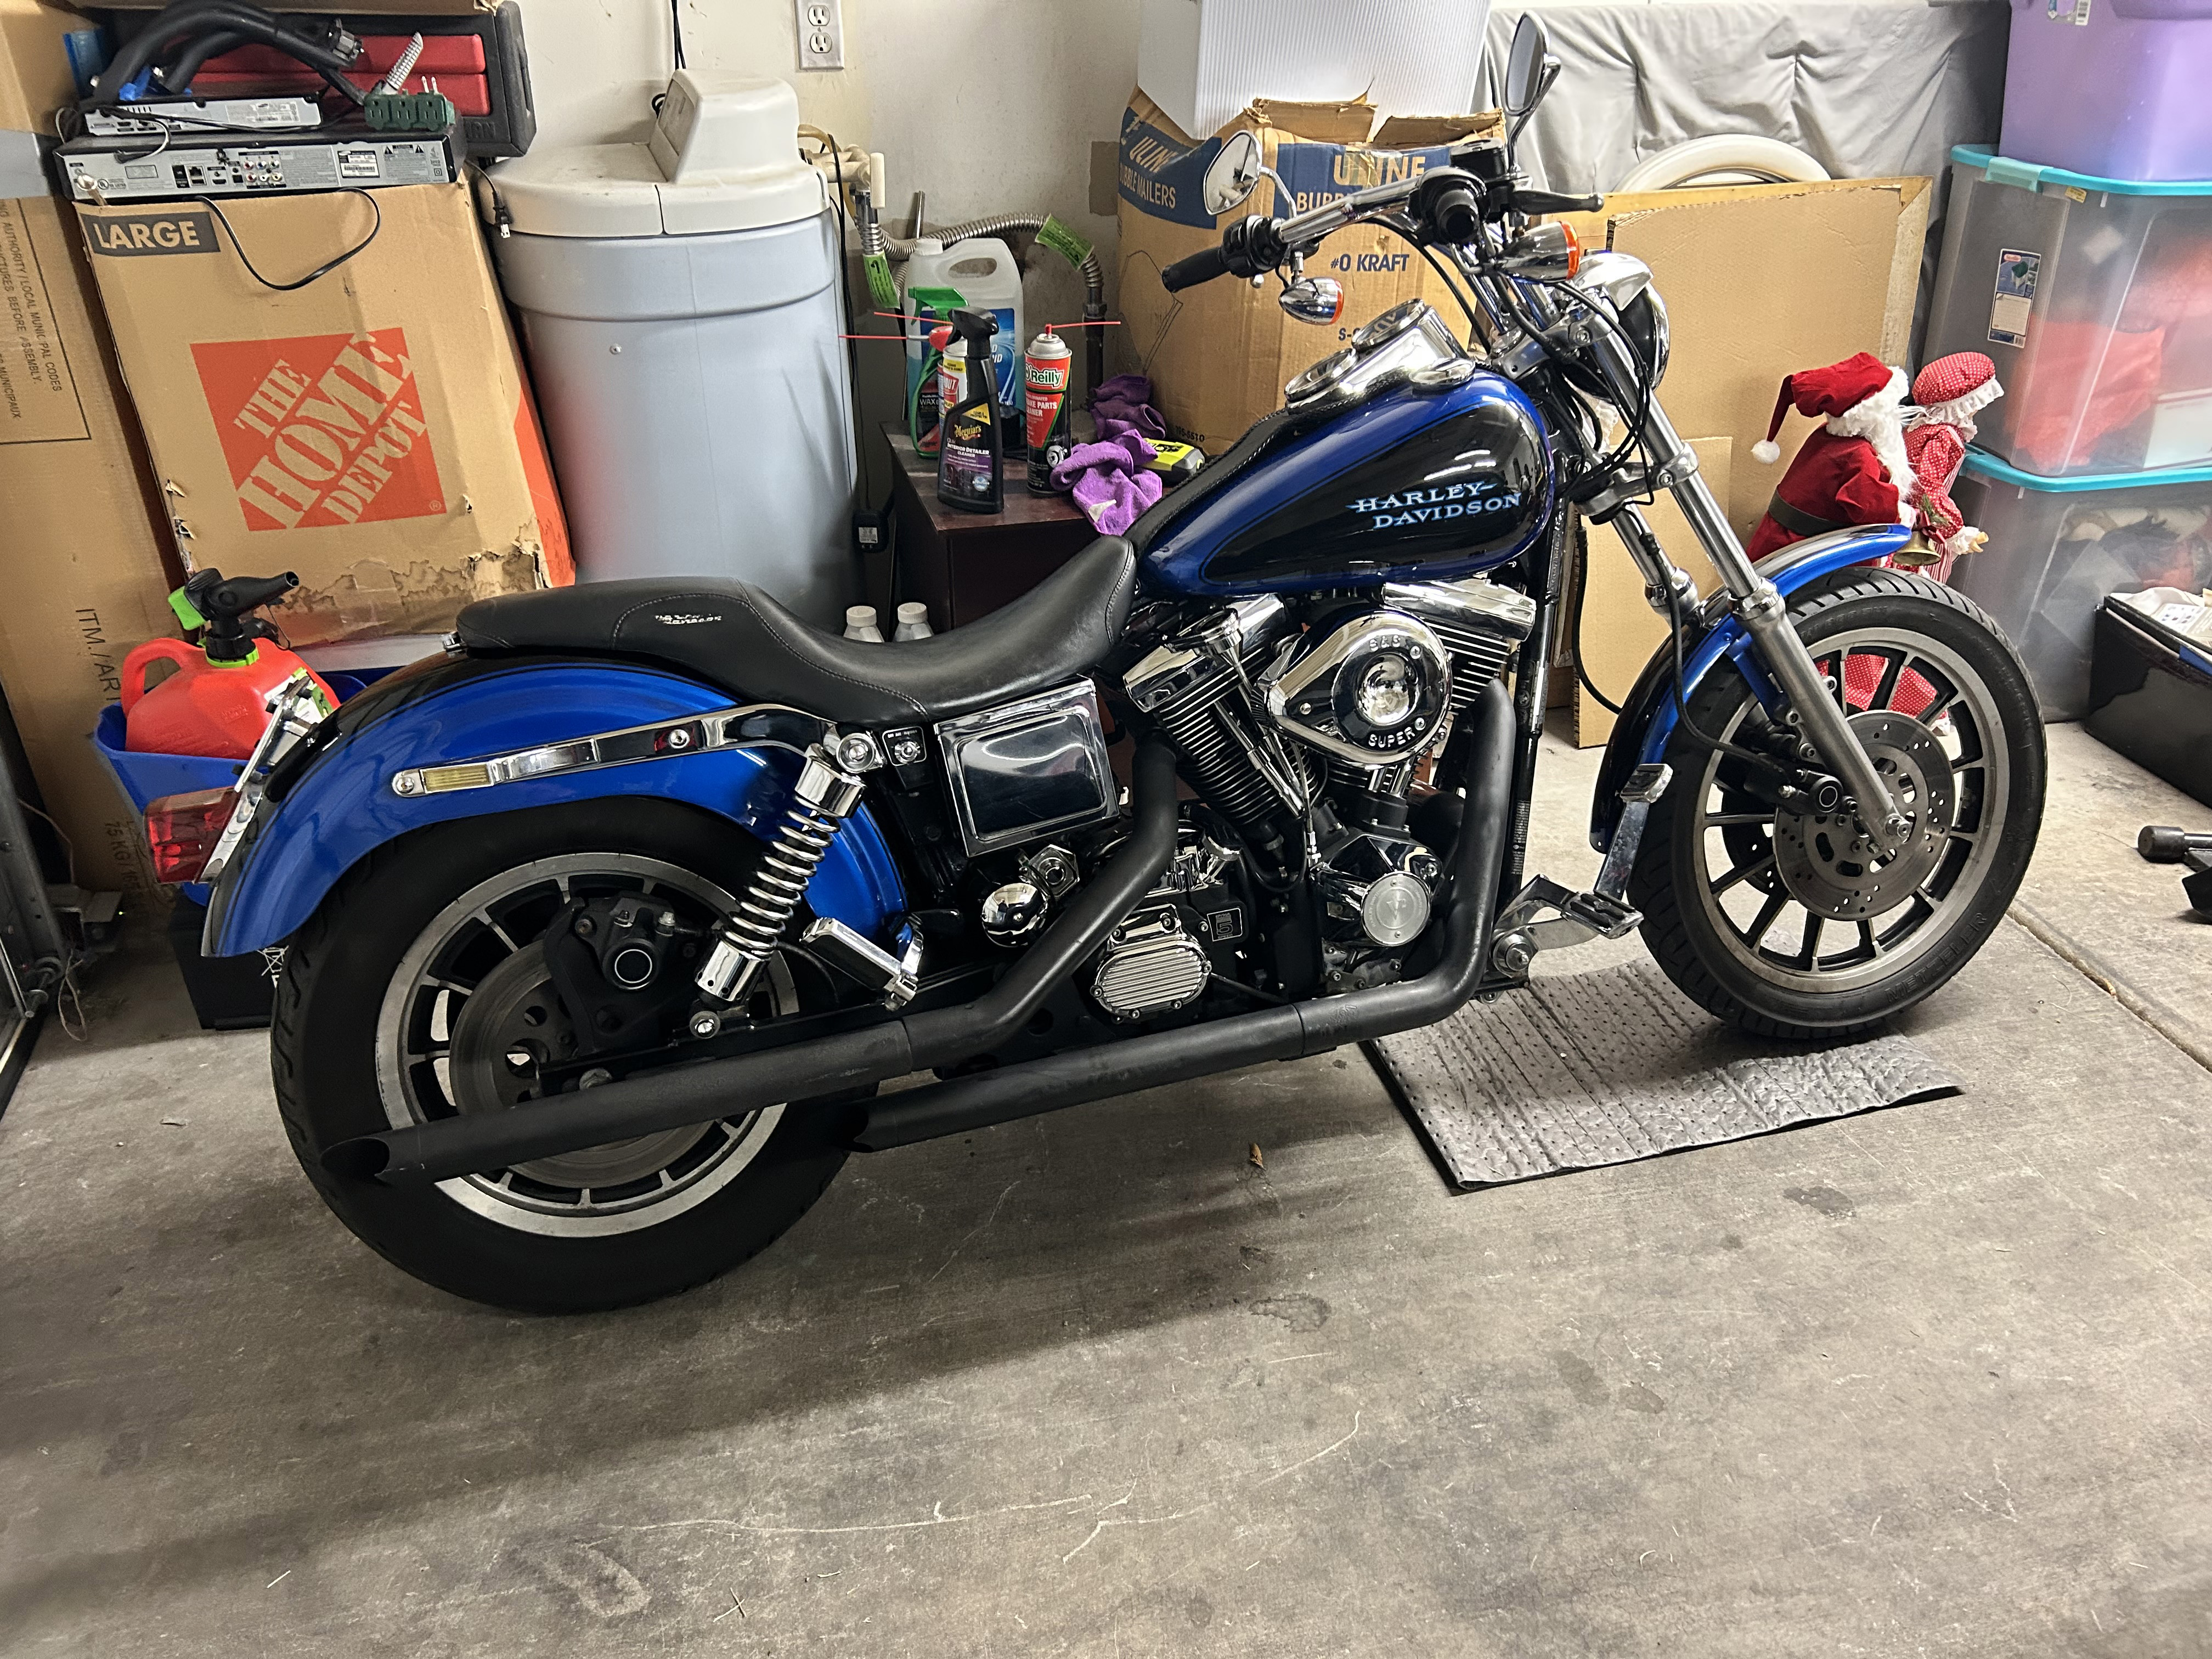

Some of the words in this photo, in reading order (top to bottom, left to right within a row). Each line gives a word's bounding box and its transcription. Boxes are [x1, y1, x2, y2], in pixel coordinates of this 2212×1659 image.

[1137, 173, 1176, 209] MAILERS
[93, 219, 200, 248] LARGE
[1357, 253, 1409, 272] KRAFT
[8, 296, 26, 331] BEFORE
[31, 312, 51, 358] MUNICPAL
[46, 362, 62, 391] CODES
[234, 359, 311, 438] THE
[1037, 401, 1057, 409] PARTS
[238, 332, 415, 528] HOME
[321, 402, 426, 523] DEPOT
[1347, 481, 1497, 513] HARLEY
[1373, 493, 1521, 529] DAVIDSON
[1368, 726, 1415, 748] SUPER
